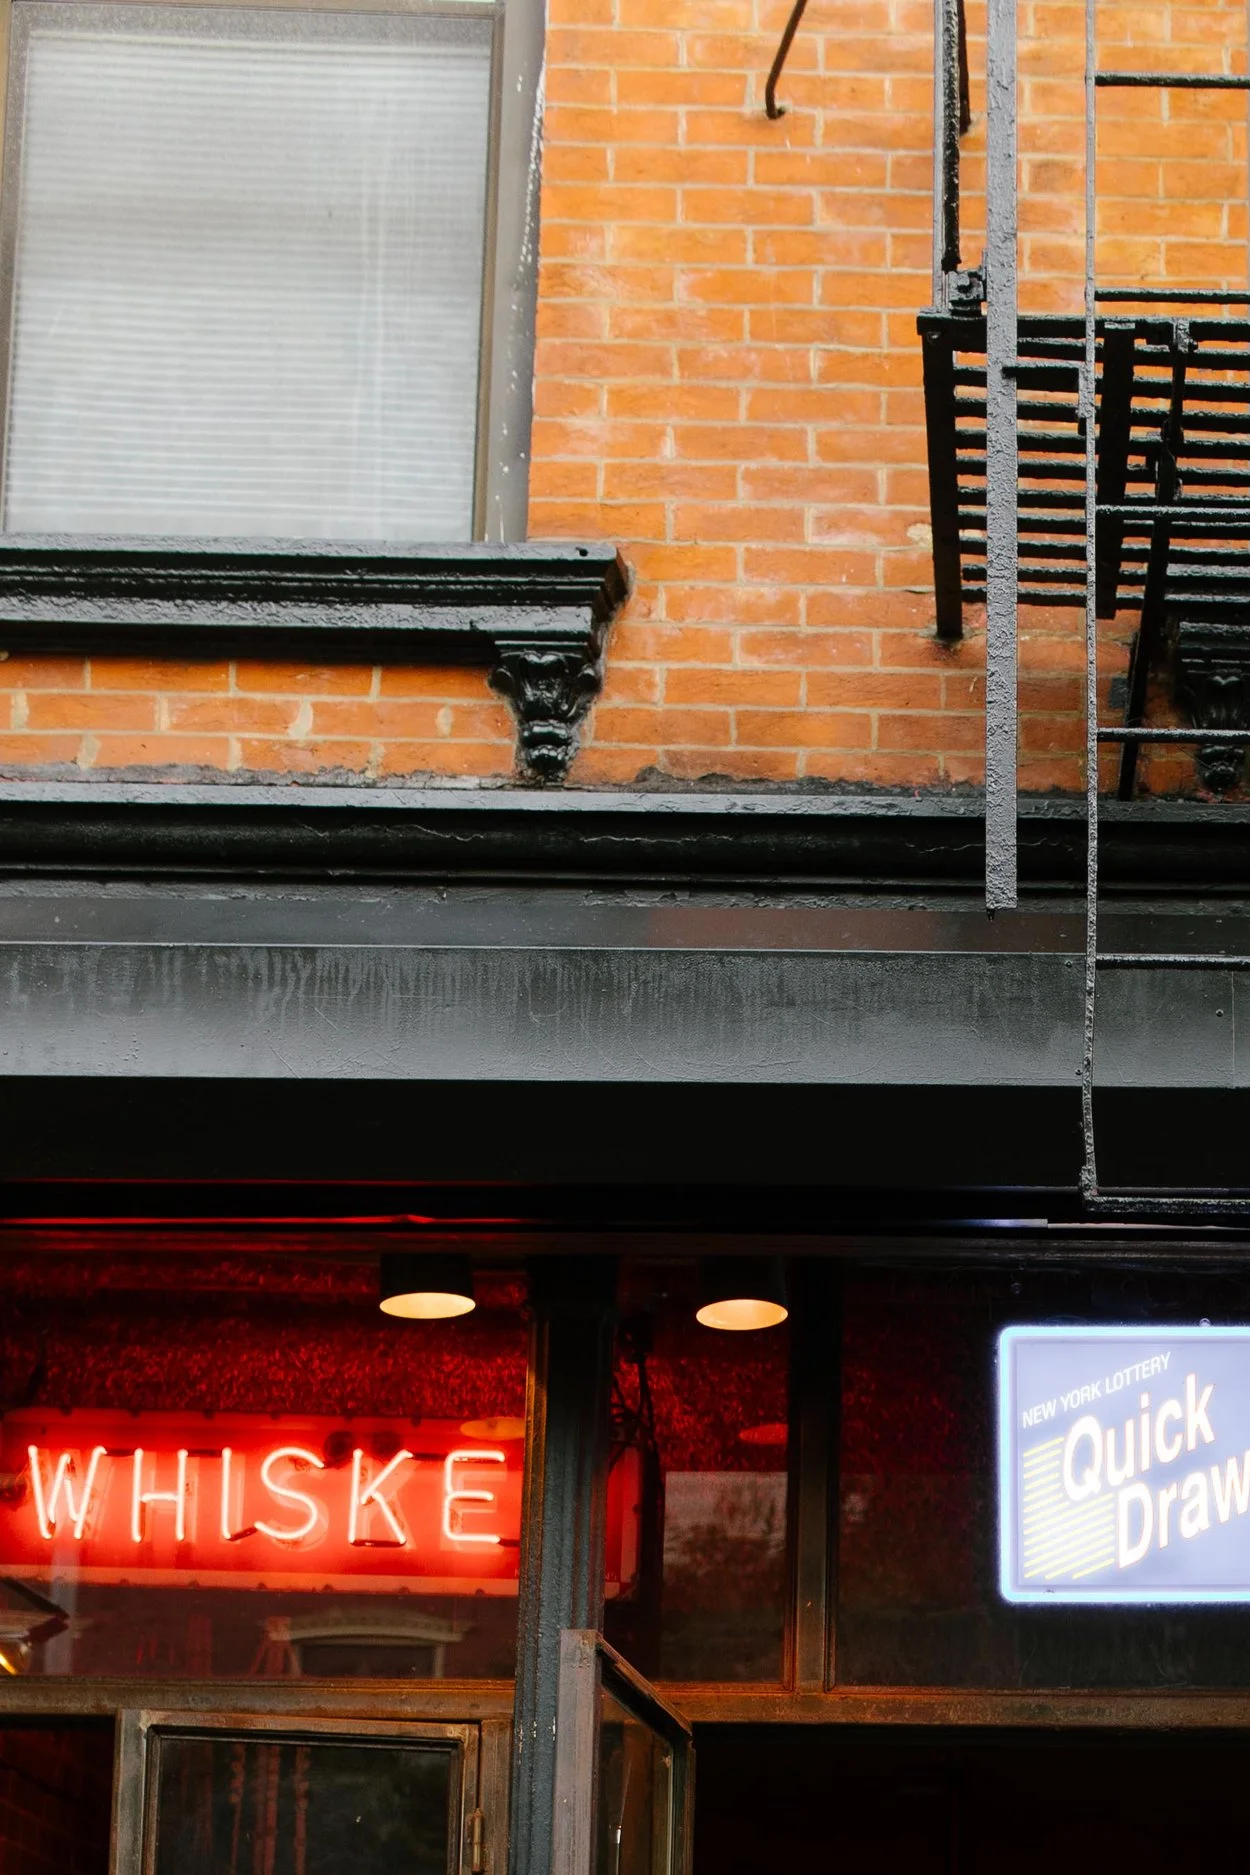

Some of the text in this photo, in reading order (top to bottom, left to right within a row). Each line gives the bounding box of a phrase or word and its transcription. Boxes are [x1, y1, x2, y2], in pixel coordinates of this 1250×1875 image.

[1022, 1351, 1171, 1430] NEW YORK LOTTERY
[1063, 1372, 1216, 1502] Quick
[27, 1445, 506, 1543] WHISKE
